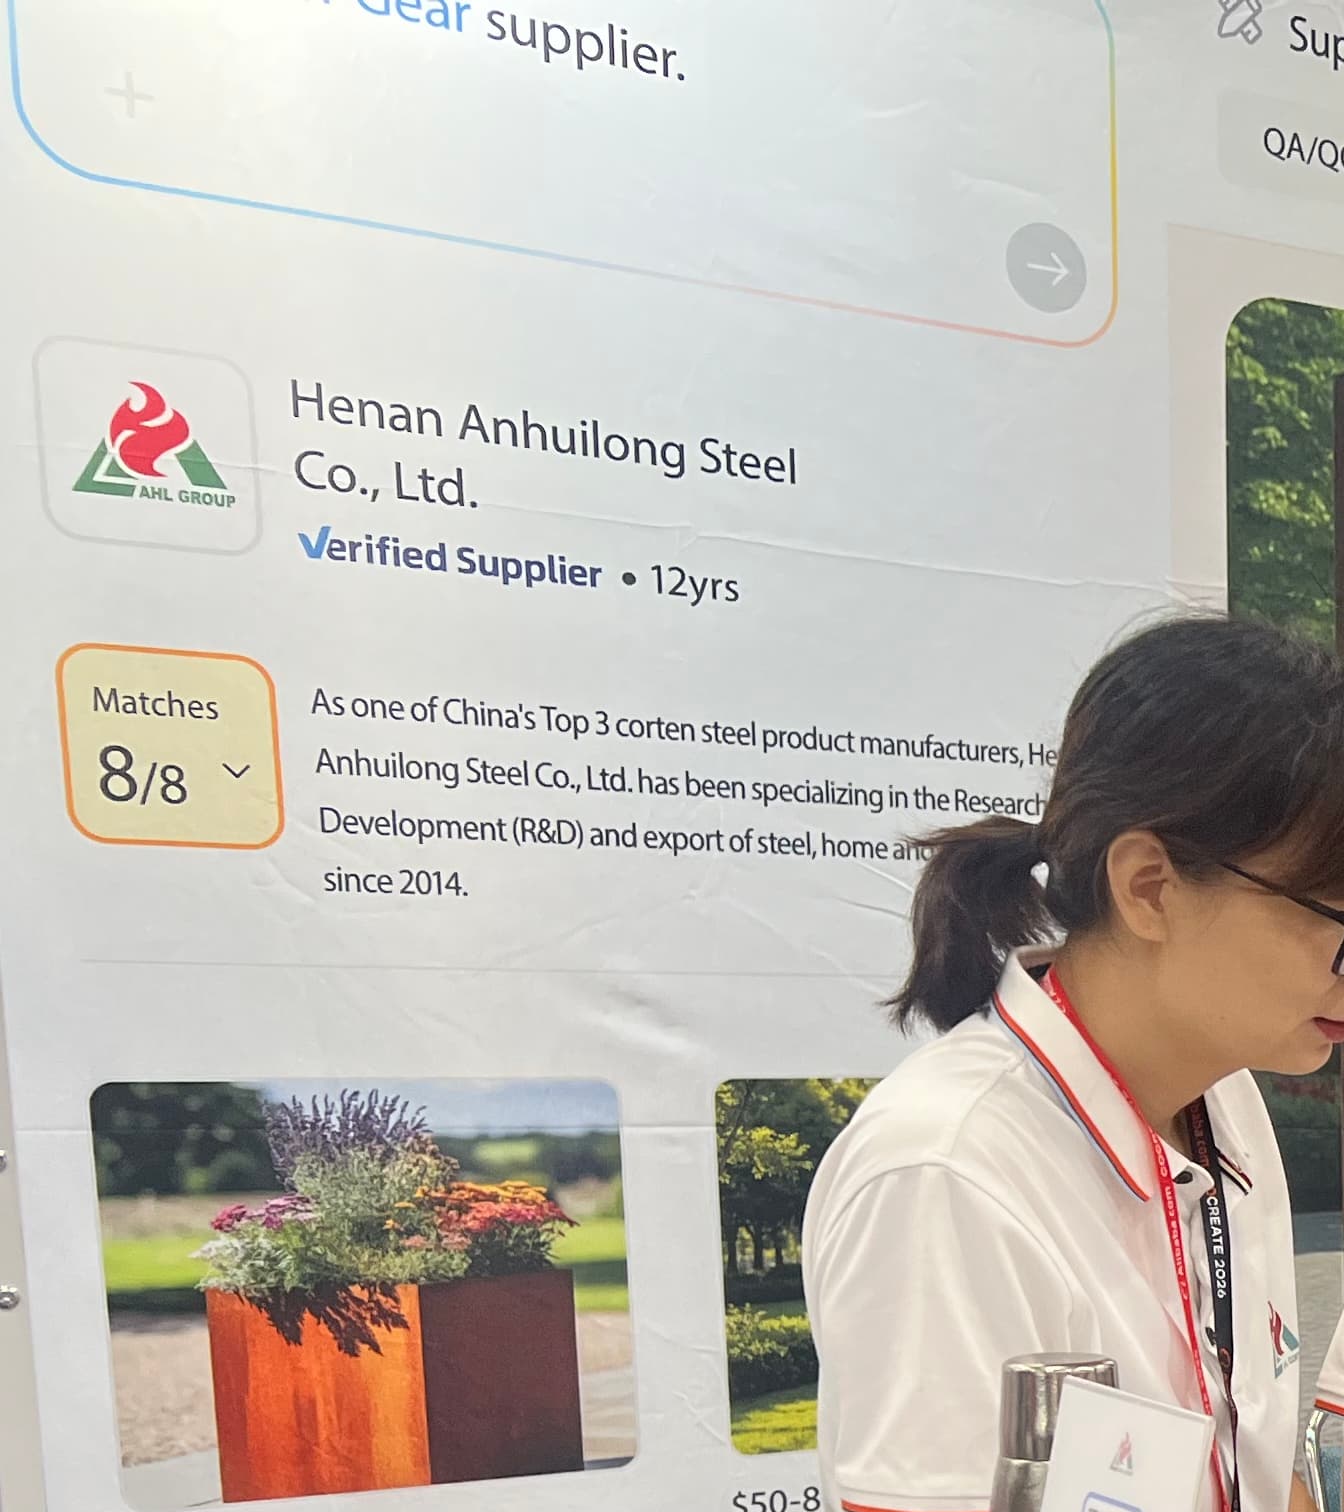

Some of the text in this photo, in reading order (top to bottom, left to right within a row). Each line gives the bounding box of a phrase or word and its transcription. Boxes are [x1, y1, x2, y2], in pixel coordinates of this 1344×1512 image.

[487, 9, 685, 81] supplier.
[290, 378, 797, 485] Henan Anhuilong Steel
[139, 484, 236, 509] AHL GROUP
[294, 450, 478, 509] Co., Ltd.
[298, 525, 740, 607] Verified Supplier 12yrs
[93, 686, 219, 721] Matches
[311, 687, 345, 717] As
[351, 696, 405, 721] one
[410, 696, 439, 723] of
[443, 698, 536, 730] China's
[539, 705, 589, 740] Top
[595, 710, 610, 735] 3
[615, 715, 696, 742] corten
[701, 720, 757, 746] steel
[762, 726, 856, 753] product
[860, 734, 1024, 768] manufacturers,
[98, 743, 189, 807] 8/8
[315, 747, 459, 789] Anhuilong
[465, 757, 529, 786] Steel
[535, 762, 581, 794] Co.,
[587, 765, 633, 794] Ltd.
[638, 767, 681, 796] has
[685, 770, 746, 800] been
[751, 779, 884, 813] specializing
[889, 784, 908, 809] in
[913, 786, 950, 812] the
[320, 805, 508, 845] Development
[512, 816, 584, 850] (R&D)
[590, 822, 637, 849] and
[643, 828, 724, 856] export
[729, 828, 755, 854] of
[757, 830, 817, 860] steel,
[821, 833, 889, 861] home
[324, 866, 469, 896] since 2014.
[1214, 1258, 1227, 1300] 2026
